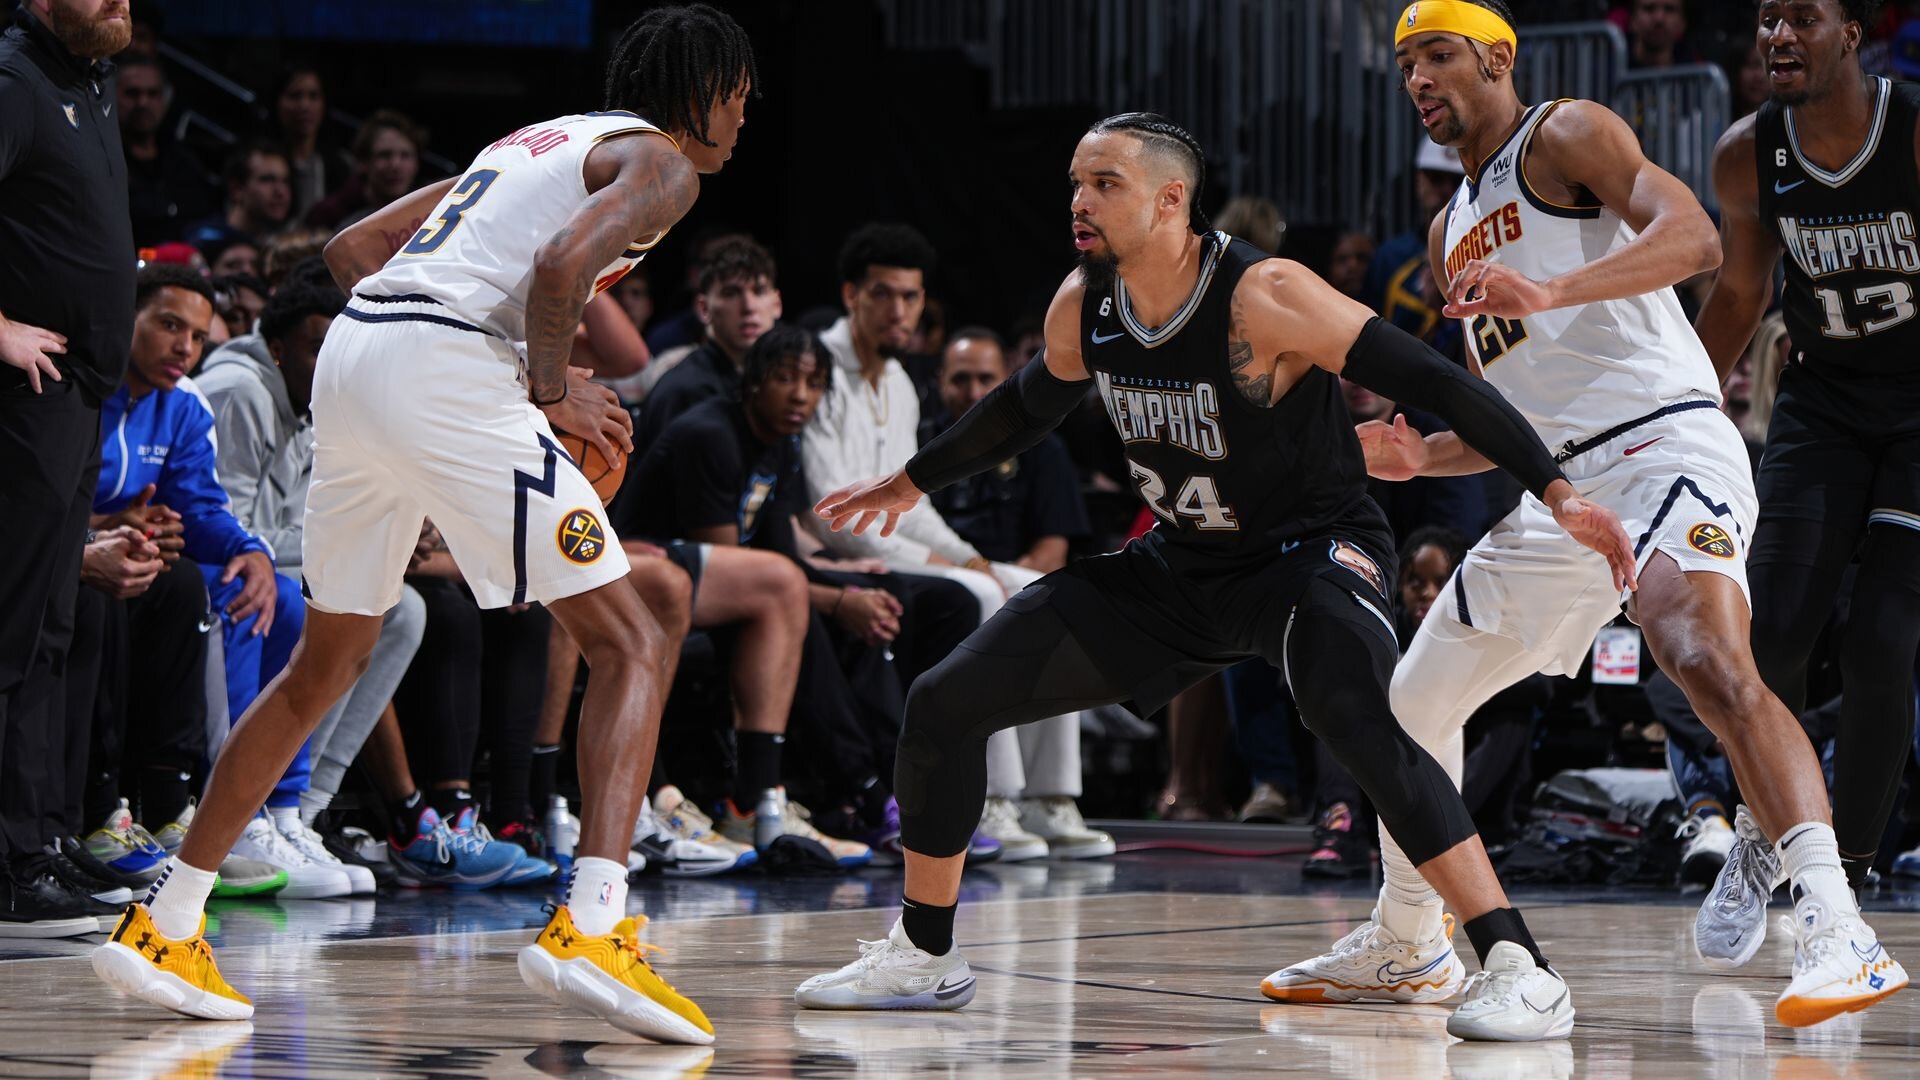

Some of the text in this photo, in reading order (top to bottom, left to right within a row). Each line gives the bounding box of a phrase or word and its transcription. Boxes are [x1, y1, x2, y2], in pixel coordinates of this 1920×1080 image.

[1493, 153, 1513, 175] WU
[1774, 148, 1788, 167] 6
[400, 167, 505, 257] 3
[1799, 212, 1885, 225] GRIZZLIES
[1446, 201, 1523, 283] NUGGETS
[1777, 211, 1920, 282] MEMPHIS
[1098, 297, 1112, 317] 6
[1814, 281, 1918, 339] 13
[1112, 375, 1191, 389] GRIZZLIES
[1094, 369, 1228, 461] MEMPHIS
[1126, 457, 1240, 531] 24
